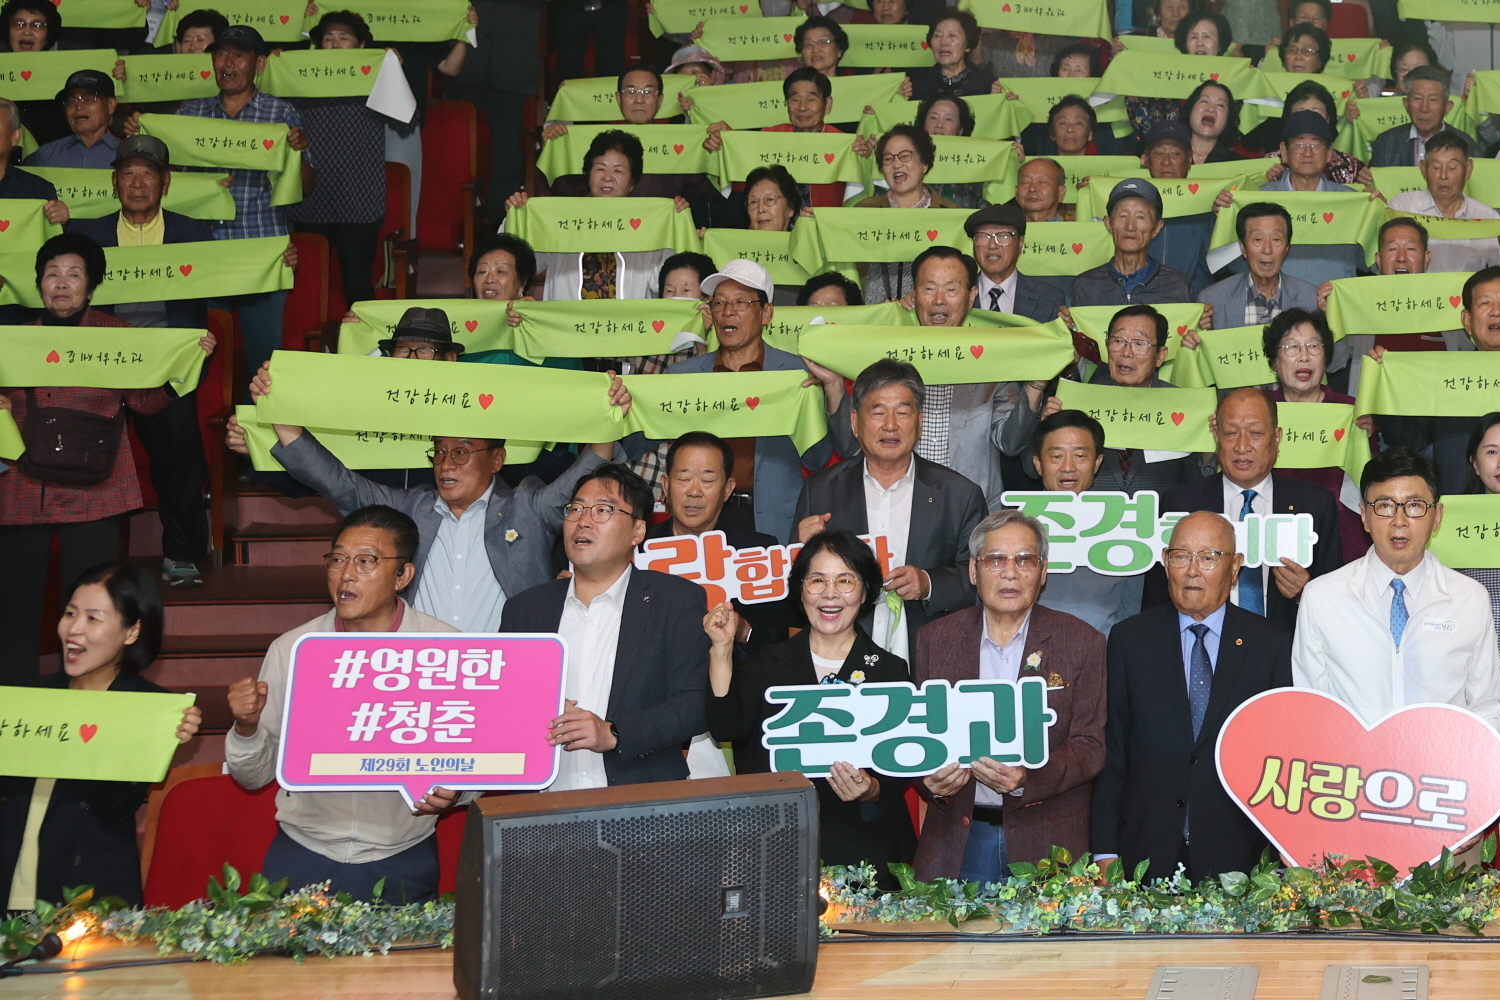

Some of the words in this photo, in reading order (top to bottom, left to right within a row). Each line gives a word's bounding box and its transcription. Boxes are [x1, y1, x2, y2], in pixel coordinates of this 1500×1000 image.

[689, 6, 736, 16] 건강하세요
[728, 34, 780, 45] 건강하세요
[865, 40, 917, 51] 건강하세요
[139, 71, 195, 82] 건강하세요
[298, 66, 357, 78] 건강하세요
[195, 136, 258, 150] 건강하세요
[760, 152, 820, 167] 건강하세요
[558, 217, 625, 231] 건강하세요
[858, 229, 922, 242] 건강하세요
[1376, 297, 1445, 312] 건강하세요
[574, 320, 647, 334] 건강하세요
[886, 346, 965, 362] 건강하세요
[1218, 349, 1260, 364] 건강하
[386, 388, 471, 409] 건강하세요
[660, 398, 740, 414] 건강하세요
[1089, 408, 1165, 425] 건강하세요
[1286, 428, 1328, 444] 하세요
[329, 648, 506, 692] #영원한
[347, 701, 476, 745] #청춘
[768, 679, 1055, 775] 존경과
[359, 758, 411, 772] 제29회
[415, 758, 476, 772] 노인의날
[1249, 756, 1468, 832] 사랑으로
